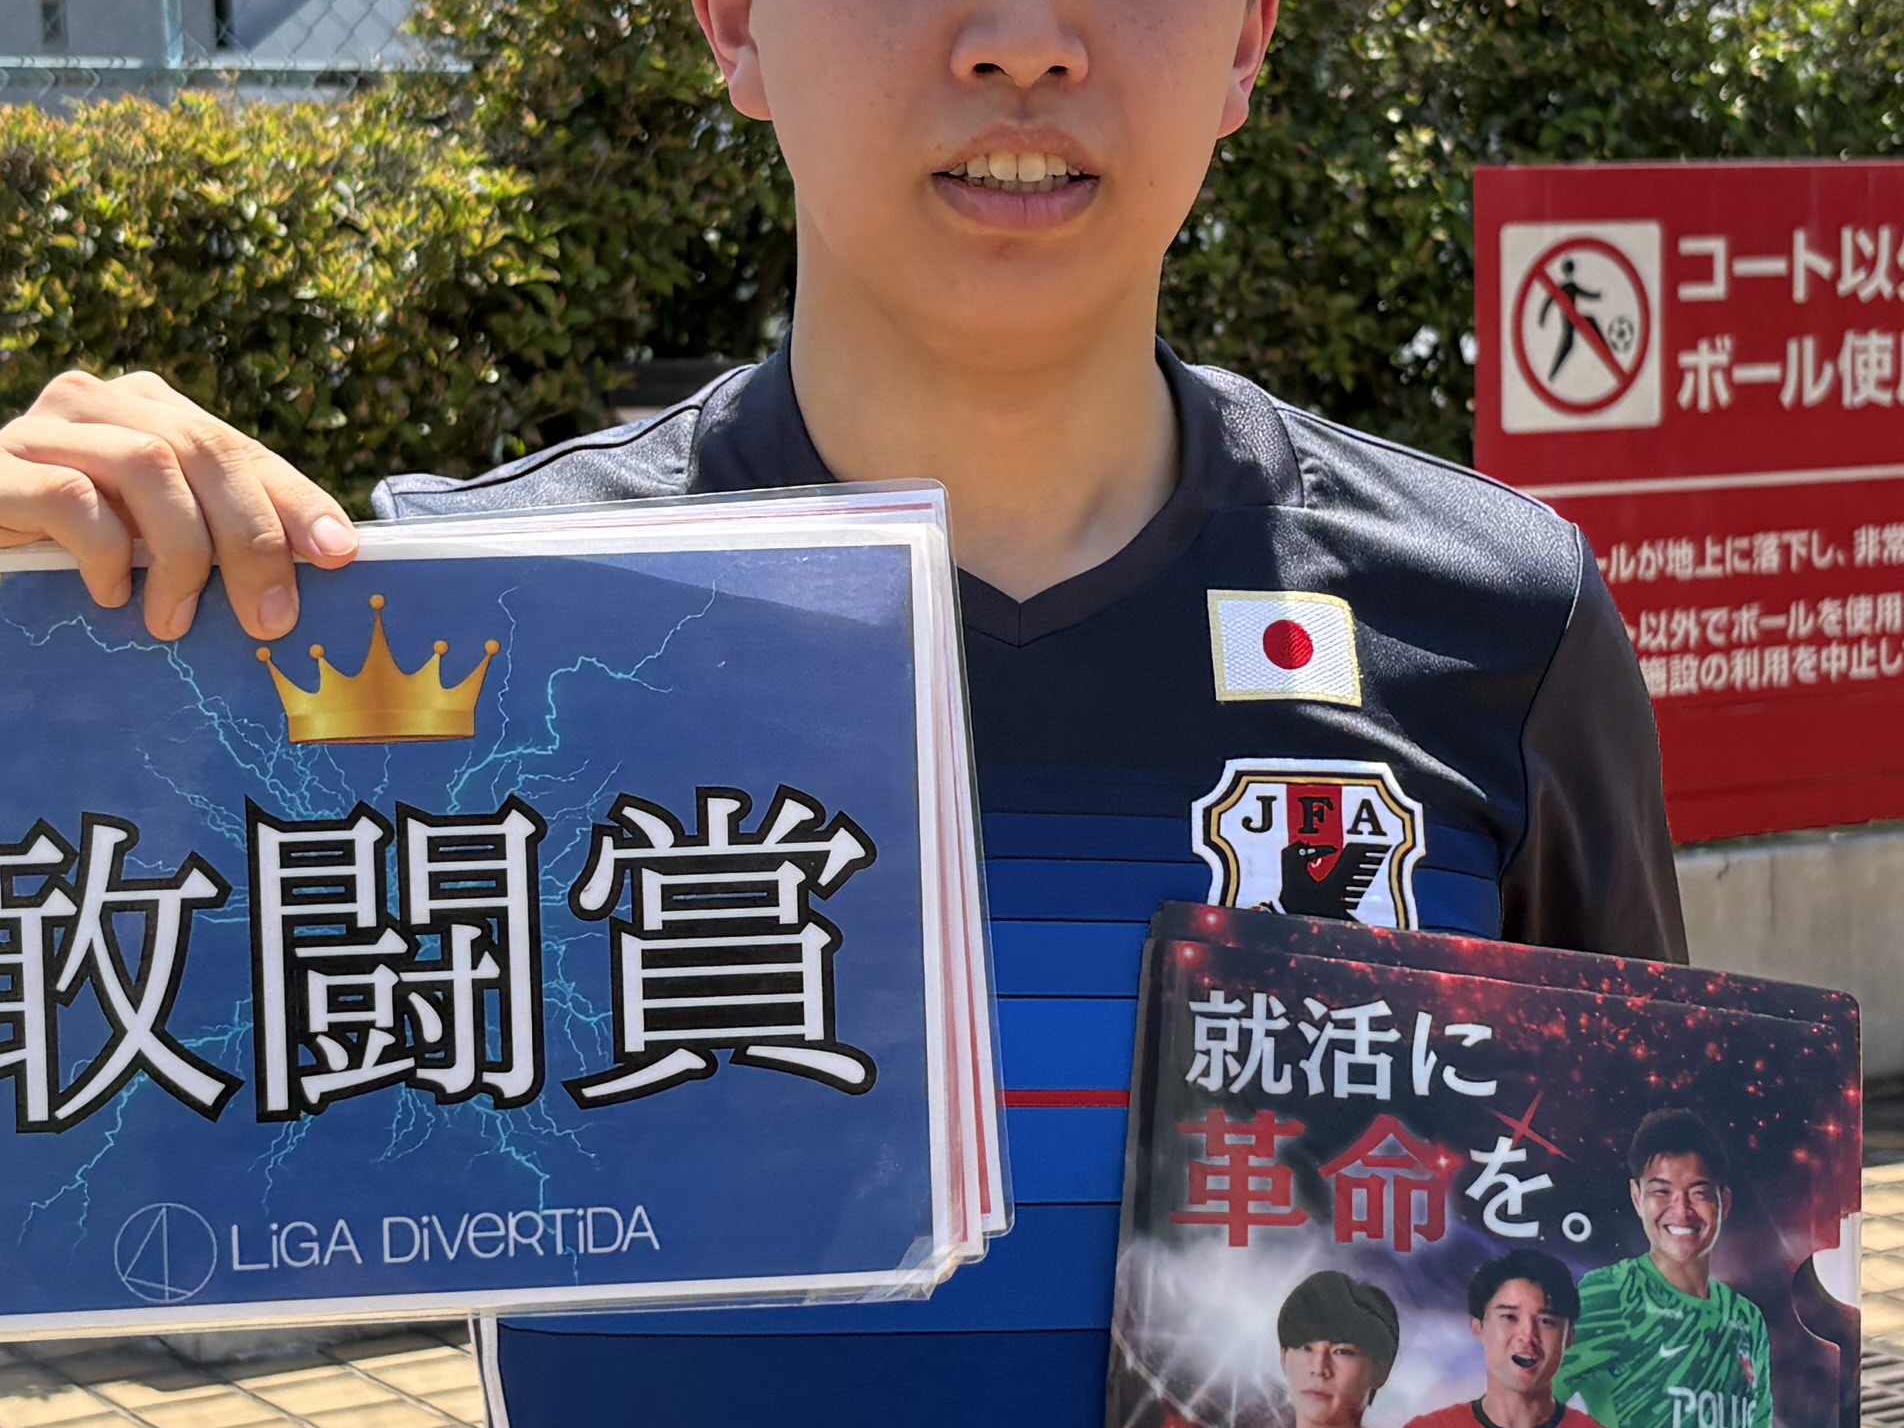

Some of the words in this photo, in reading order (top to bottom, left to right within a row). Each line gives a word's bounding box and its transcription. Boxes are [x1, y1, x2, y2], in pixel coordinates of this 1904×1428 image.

[1242, 795, 1387, 836] JFA
[1185, 990, 1497, 1100] 就活に
[1169, 1108, 1592, 1253] 革命を。
